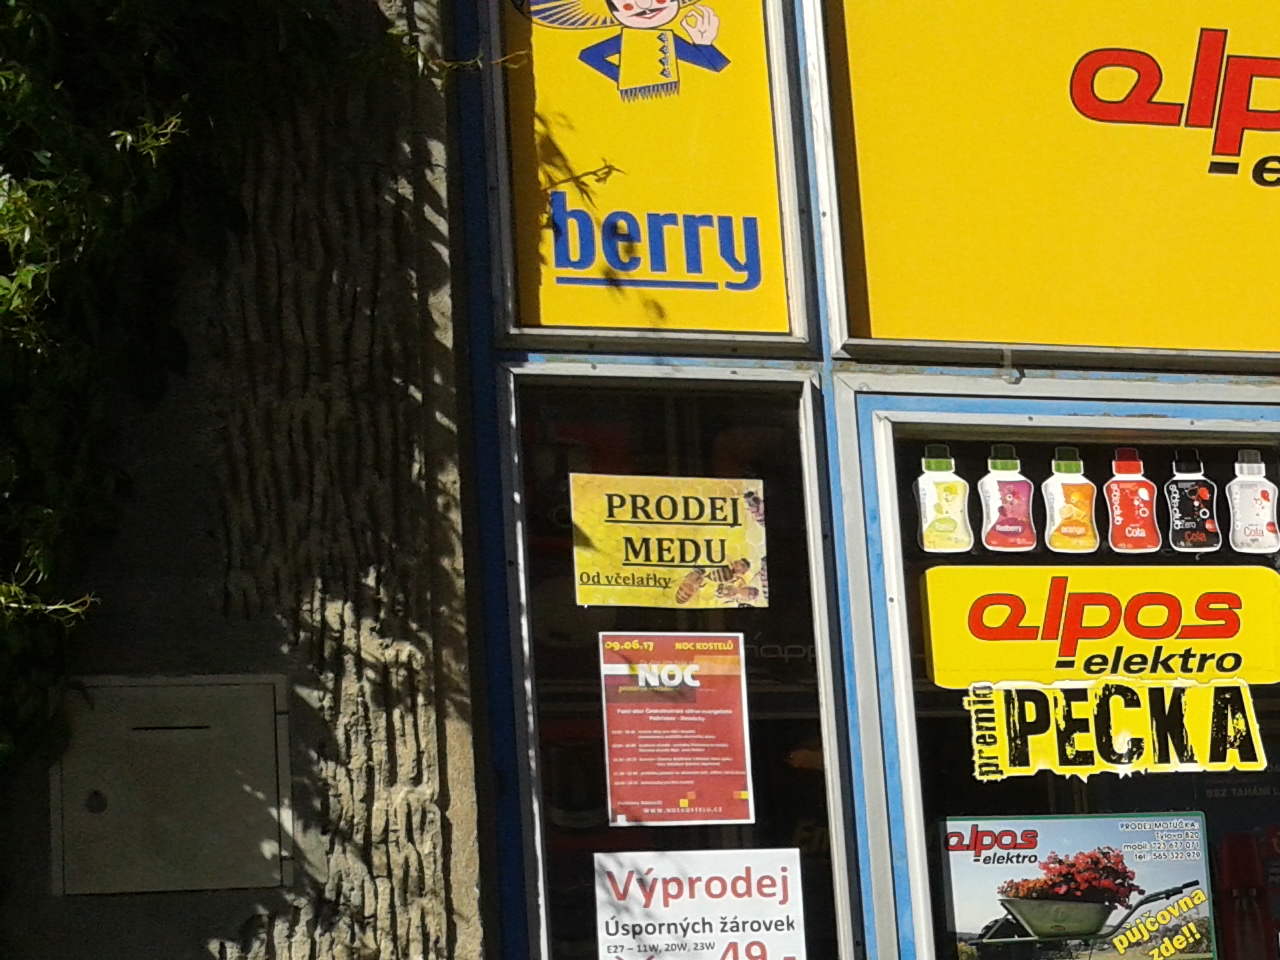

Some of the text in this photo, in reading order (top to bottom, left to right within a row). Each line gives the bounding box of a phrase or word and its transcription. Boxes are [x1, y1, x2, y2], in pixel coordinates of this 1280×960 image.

[551, 190, 762, 291] berry
[605, 493, 742, 527] PRODEJ
[1125, 527, 1146, 538] Cola
[1184, 530, 1207, 543] Cola
[1243, 526, 1264, 537] Cola
[623, 537, 726, 564] MEDU
[580, 571, 672, 589] Od včelařky
[968, 576, 1242, 657] elpos
[675, 642, 694, 650] NOC
[638, 664, 701, 687] NOC
[976, 684, 1259, 780] premio PECKA
[944, 824, 1039, 857] elpos
[606, 866, 790, 908] Výprodej
[605, 915, 796, 939] Úsporných žárovek
[1112, 888, 1207, 955] půjčovna
[607, 944, 624, 954] E27
[694, 942, 716, 951] 23W
